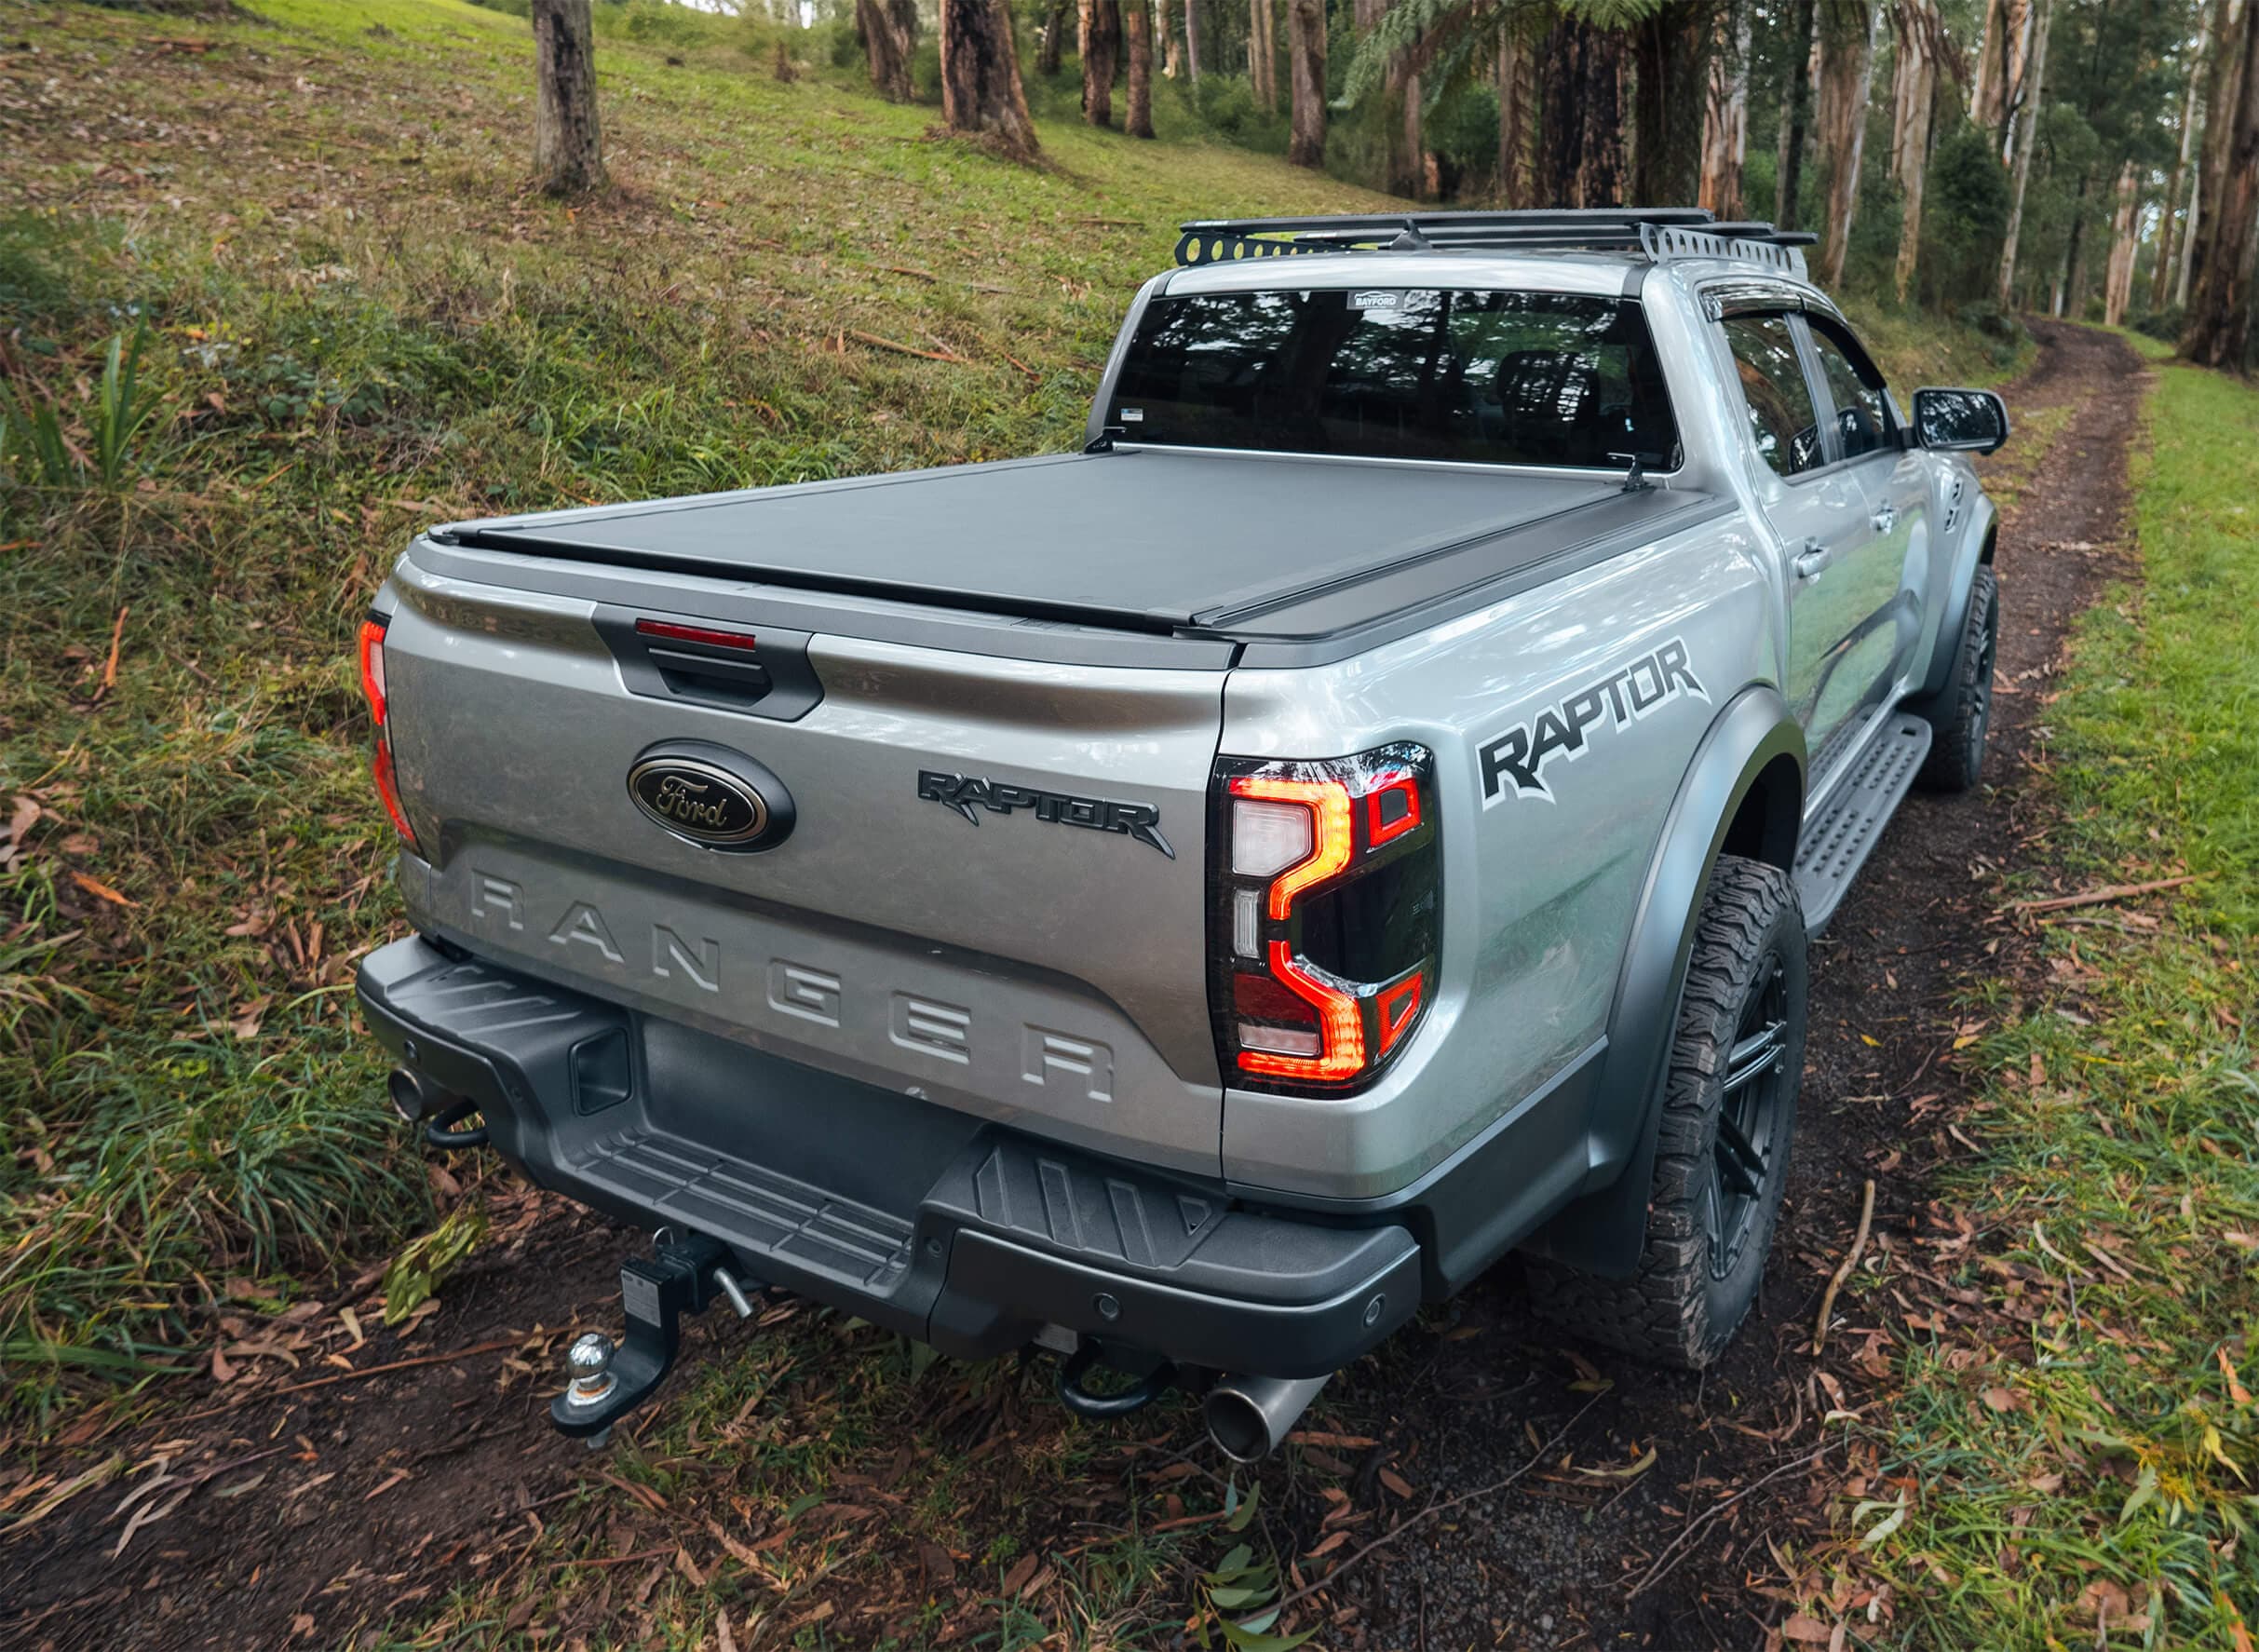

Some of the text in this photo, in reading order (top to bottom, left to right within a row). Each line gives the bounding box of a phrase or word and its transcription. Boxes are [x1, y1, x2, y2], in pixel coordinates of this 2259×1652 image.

[1355, 297, 1397, 306] BAYFORD
[1476, 636, 1711, 810] RAPTOR
[655, 775, 728, 827] Ford
[917, 768, 1176, 860] RAPTOR
[471, 869, 1115, 1103] RANGER
